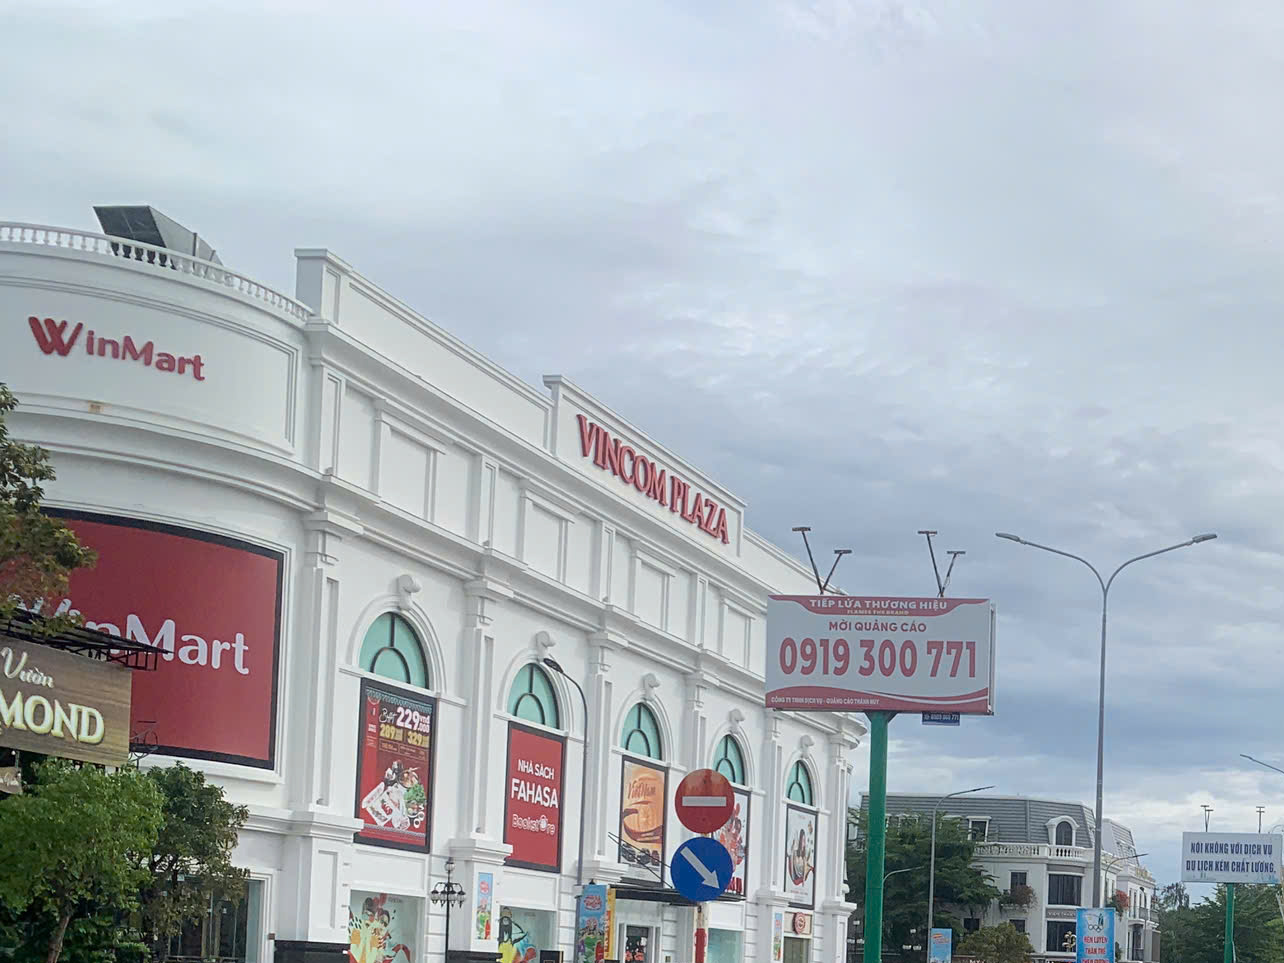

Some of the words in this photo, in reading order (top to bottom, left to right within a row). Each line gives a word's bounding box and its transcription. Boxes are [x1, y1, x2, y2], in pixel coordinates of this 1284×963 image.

[28, 316, 205, 381] WinMart
[576, 413, 666, 508] VINCOM
[670, 474, 730, 545] PLAZA
[810, 598, 835, 608] TIẾP
[865, 598, 917, 610] THƯƠNG
[919, 600, 947, 611] HIỆU
[828, 619, 852, 631] MỜI
[854, 619, 898, 632] QUẢNG
[900, 620, 927, 633] CÁO
[779, 637, 850, 676] 0919
[858, 639, 917, 677] 300
[926, 640, 976, 678] 771
[396, 706, 419, 731] 229
[517, 758, 533, 774] NHÀ
[535, 763, 555, 780] SÁCH
[511, 777, 559, 809] FAHASA
[1191, 841, 1203, 854] NÓI
[1205, 841, 1228, 855] KHÔNG
[1230, 842, 1242, 855] VỚI
[1244, 844, 1261, 857] DỊCH
[1263, 844, 1272, 857] VỤ
[1186, 860, 1196, 871] DU
[1215, 859, 1229, 872] KÉM
[1231, 858, 1249, 872] CHẤT
